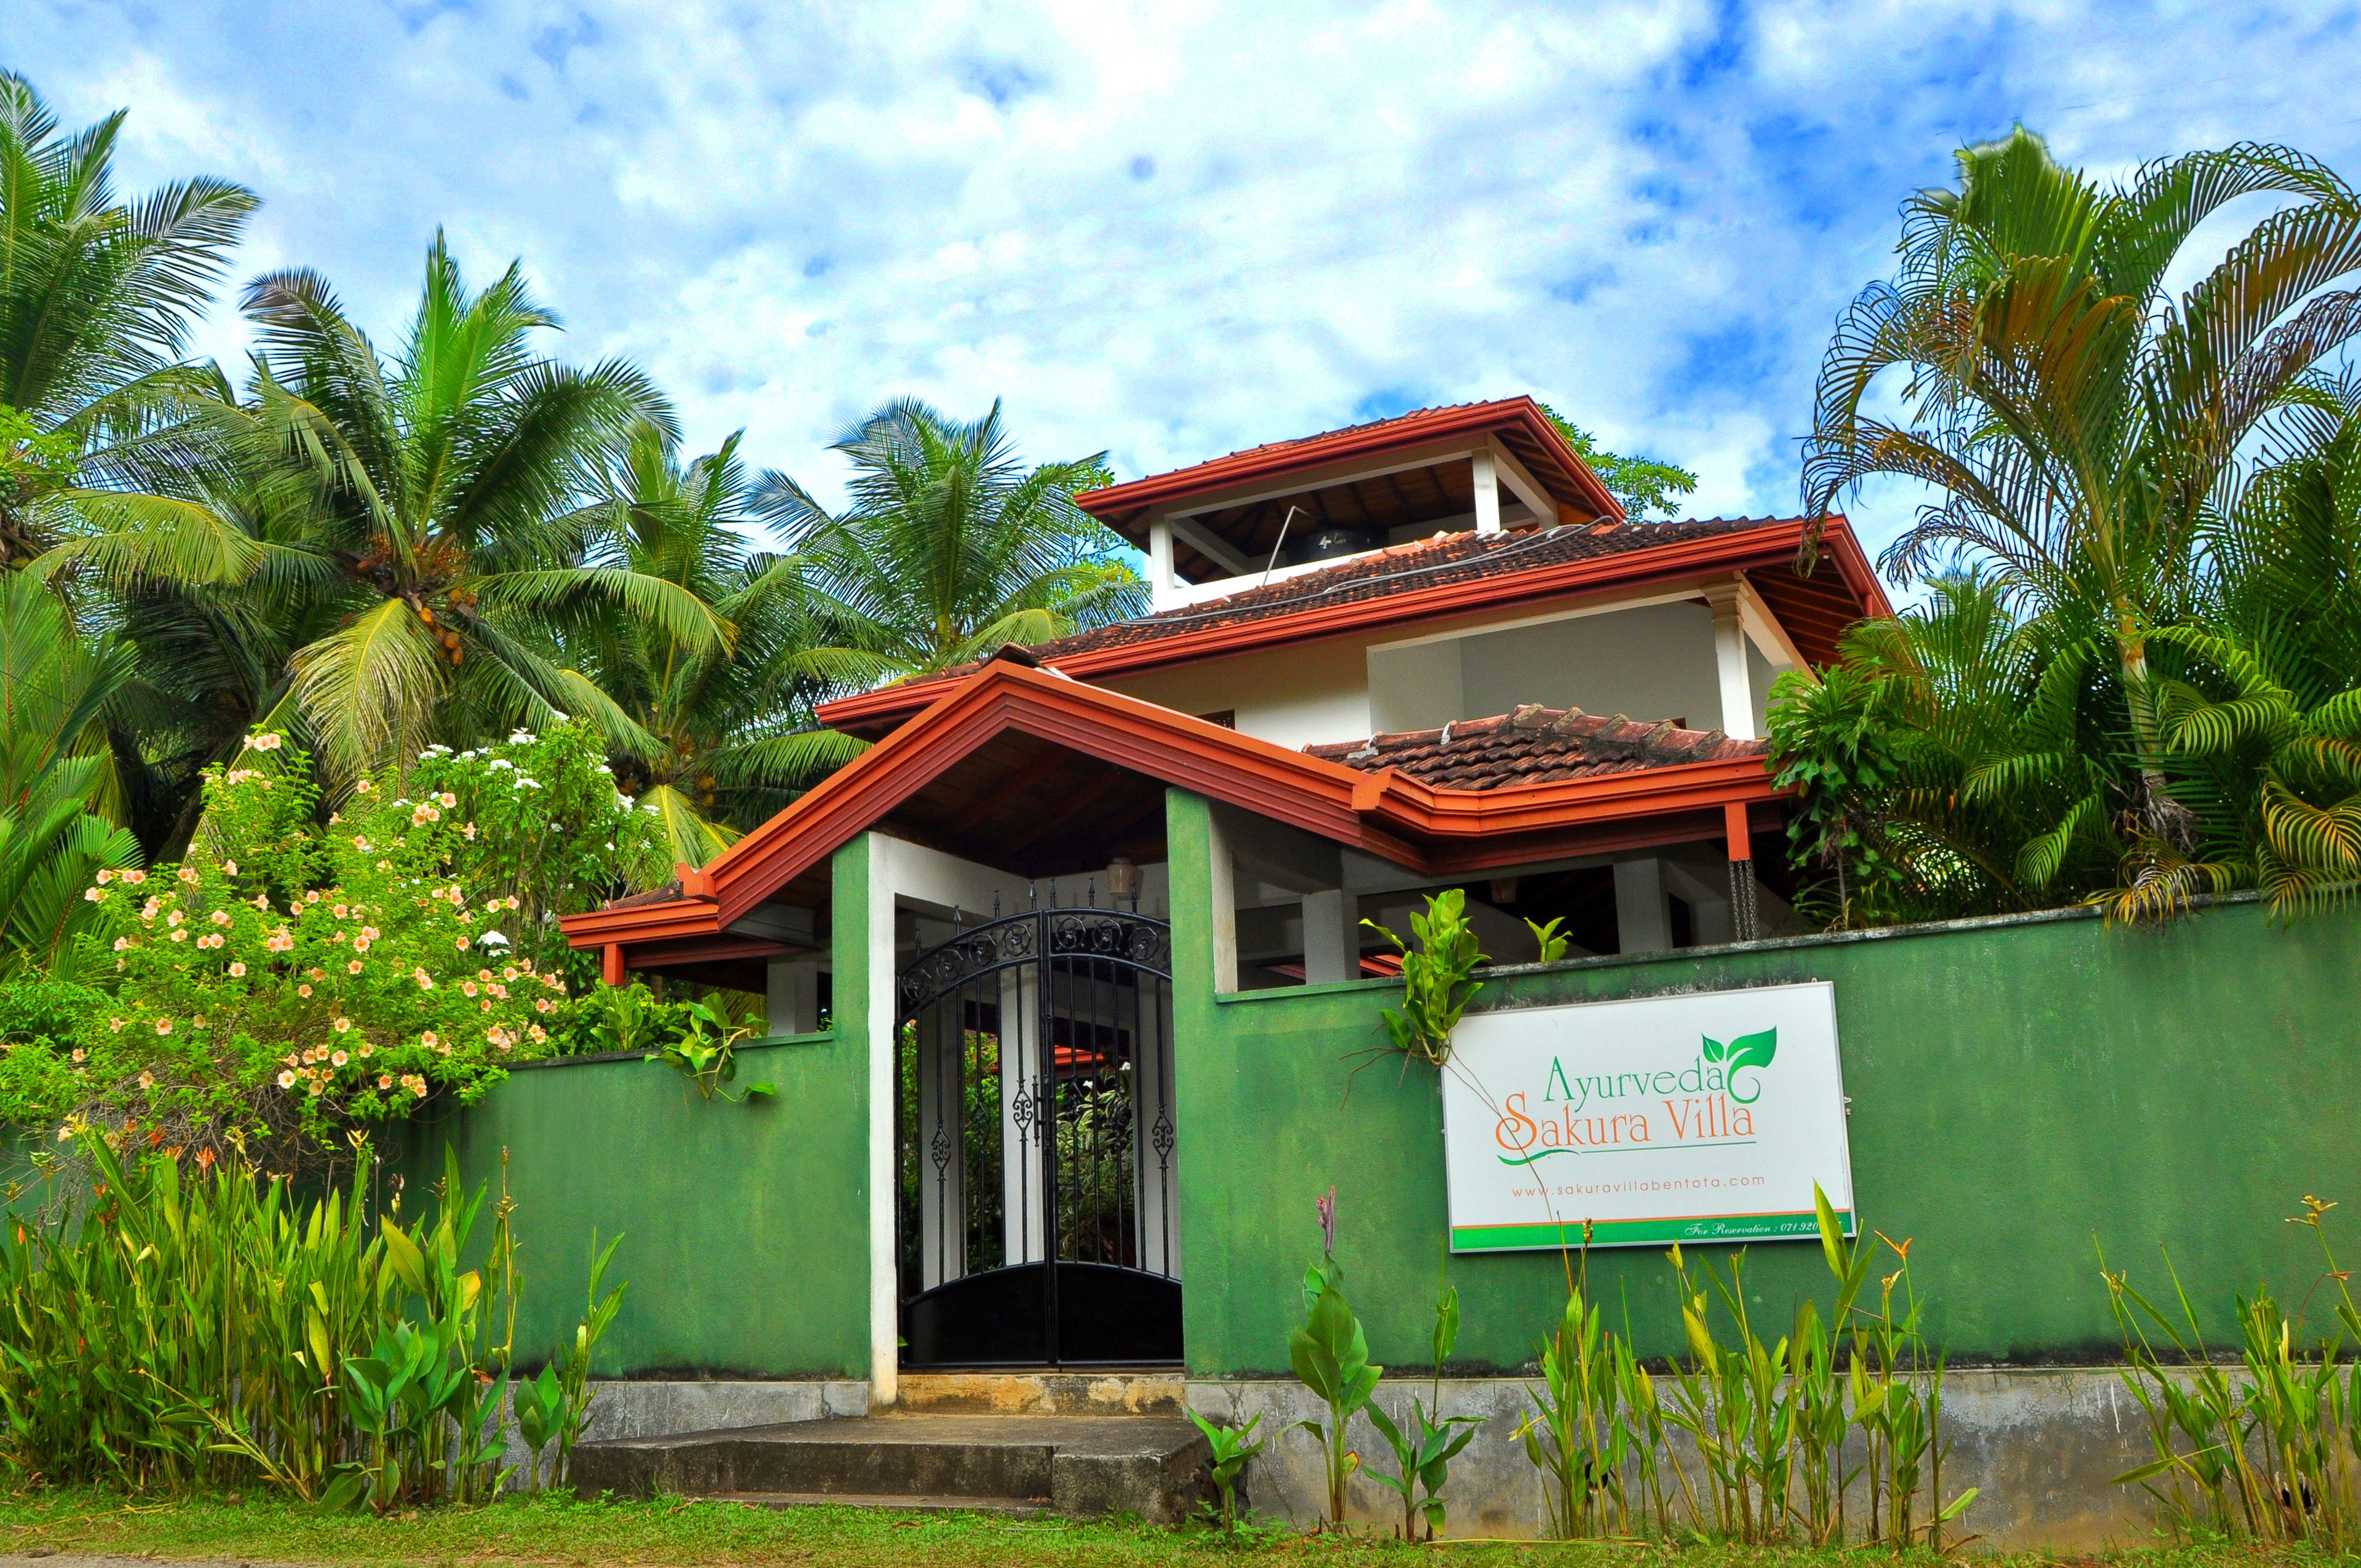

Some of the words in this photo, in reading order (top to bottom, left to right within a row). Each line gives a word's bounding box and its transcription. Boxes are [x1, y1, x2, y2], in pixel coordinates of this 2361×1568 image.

[1543, 1055, 1726, 1113] Ayurveda
[1495, 1091, 1651, 1150] Sakura
[1662, 1093, 1756, 1140] Villa
[1512, 1175, 1766, 1197] www.sakuravillabentota.com
[1685, 1222, 1708, 1236] For
[1712, 1222, 1771, 1235] Reservation
